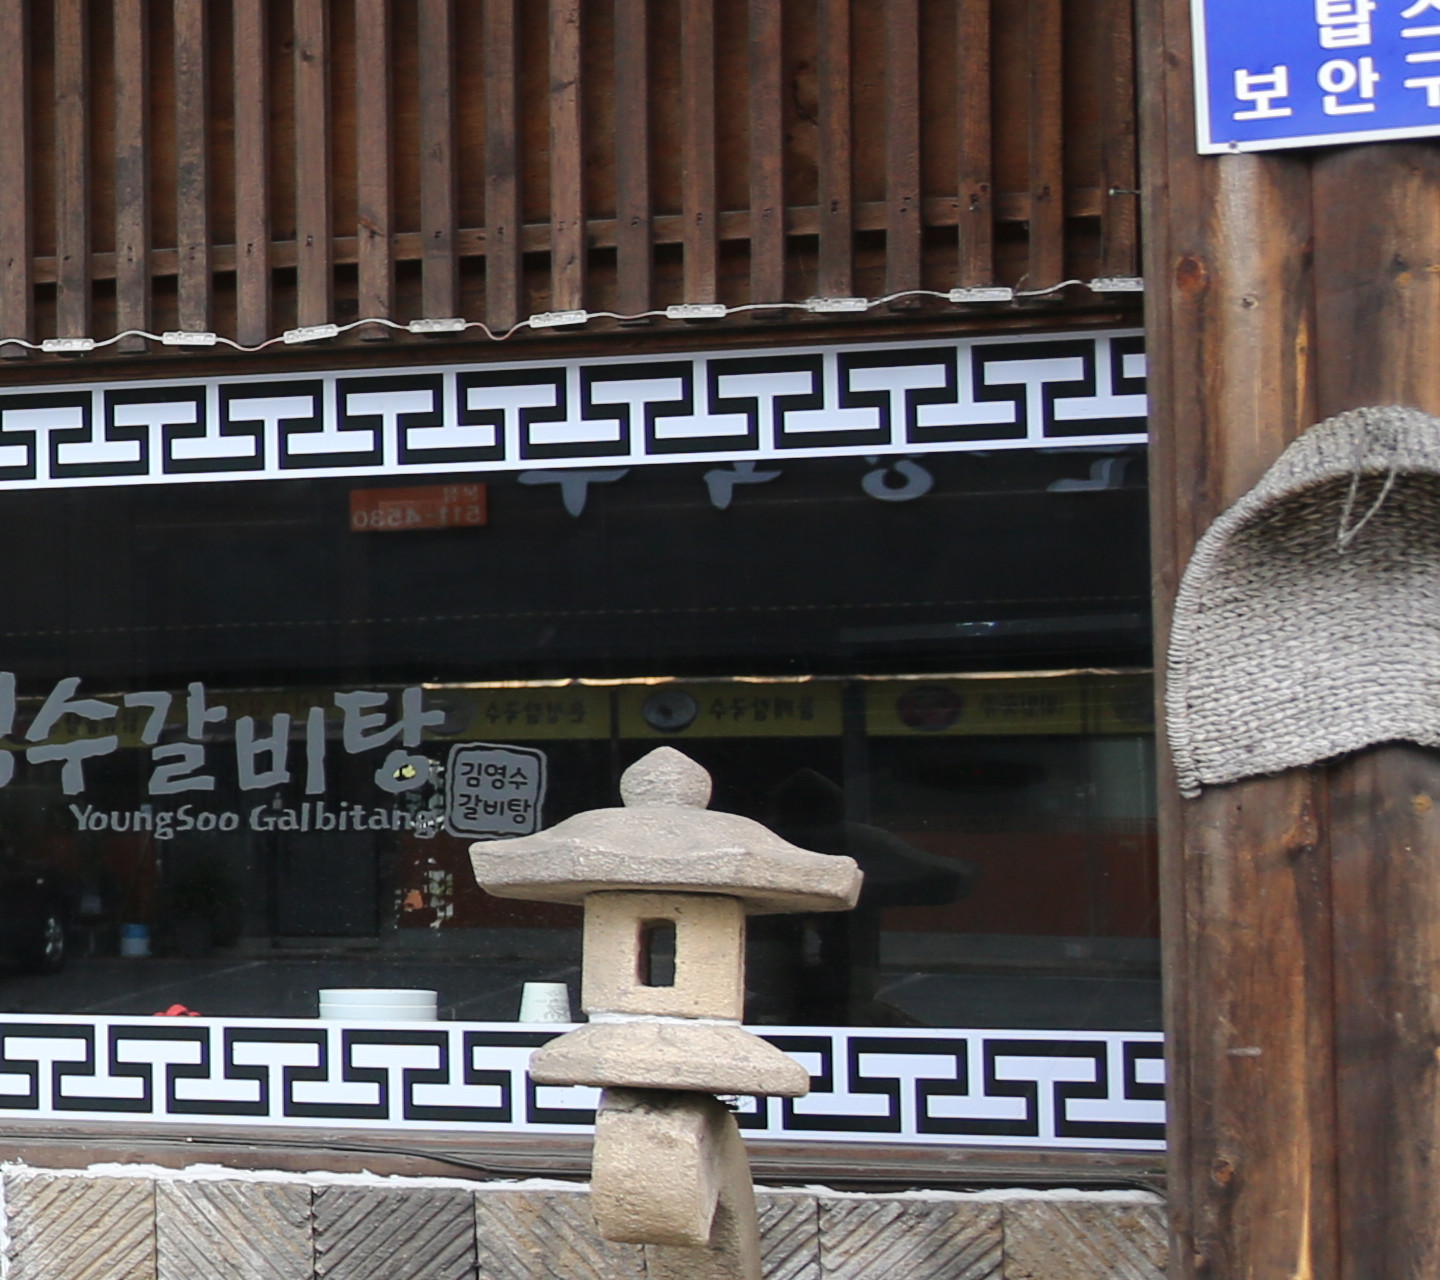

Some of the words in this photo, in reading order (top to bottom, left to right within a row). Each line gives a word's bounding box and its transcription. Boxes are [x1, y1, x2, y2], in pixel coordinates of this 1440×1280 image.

[460, 760, 530, 791] 김영수
[69, 803, 240, 839] YoungSoo
[458, 792, 532, 822] 갈비탕
